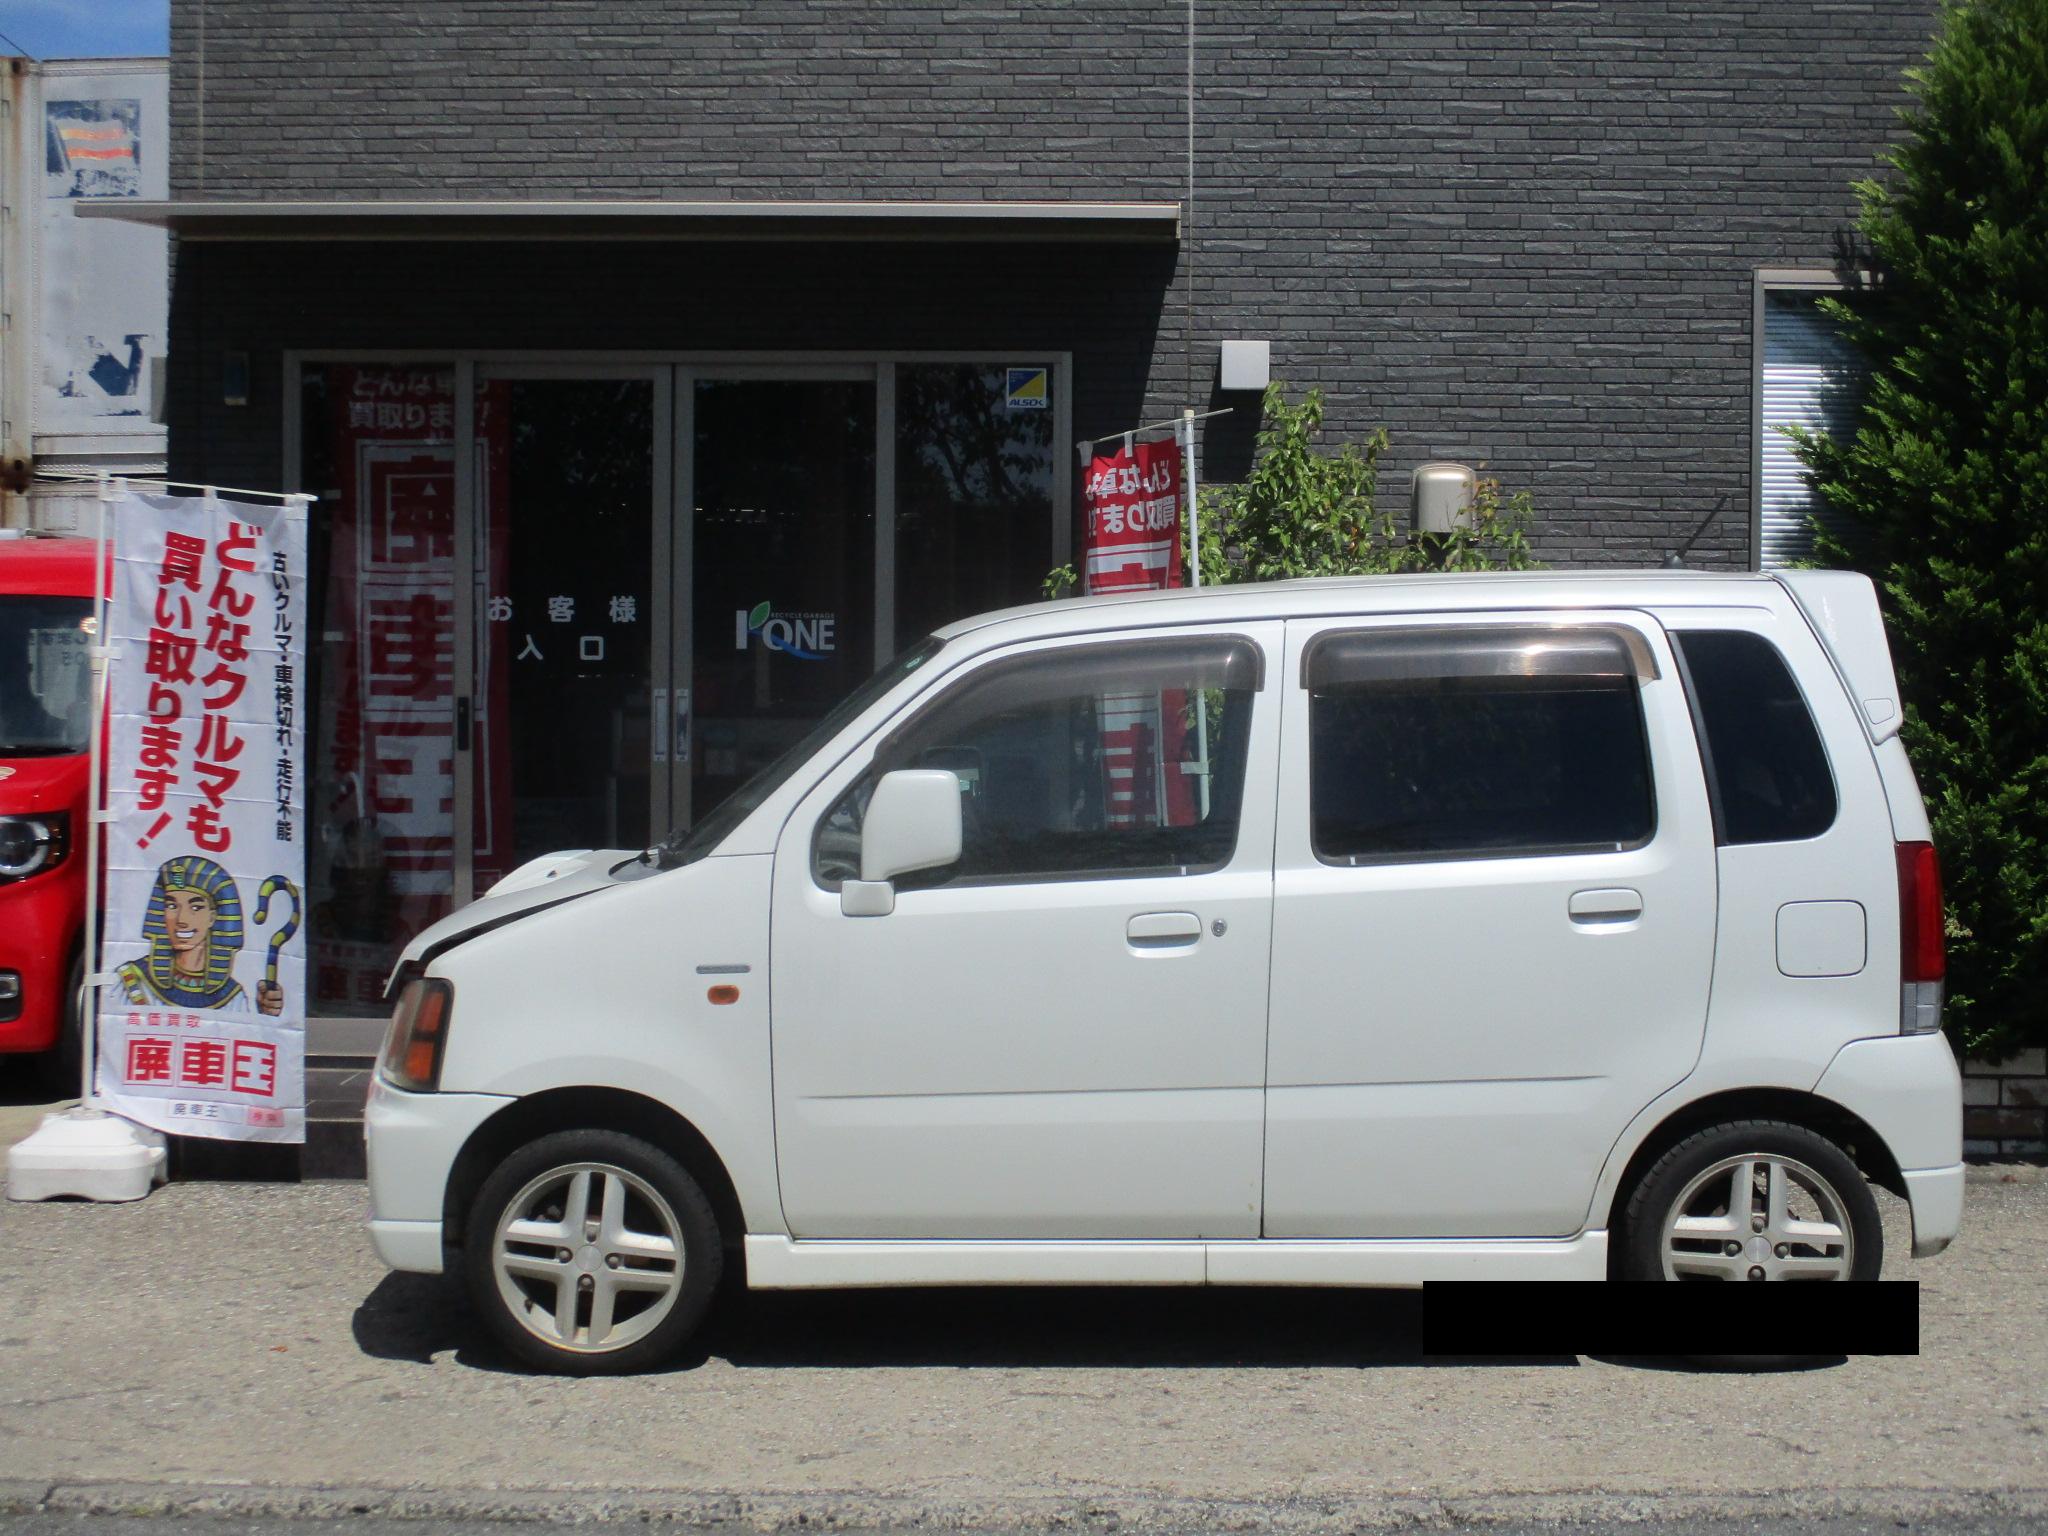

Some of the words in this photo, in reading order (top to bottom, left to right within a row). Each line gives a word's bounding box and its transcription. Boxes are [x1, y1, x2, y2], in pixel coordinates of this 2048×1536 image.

[487, 595, 637, 623] お客様
[770, 611, 802, 619] RECYCLE
[517, 634, 605, 662] 入口
[186, 521, 264, 853] どんなクルマも
